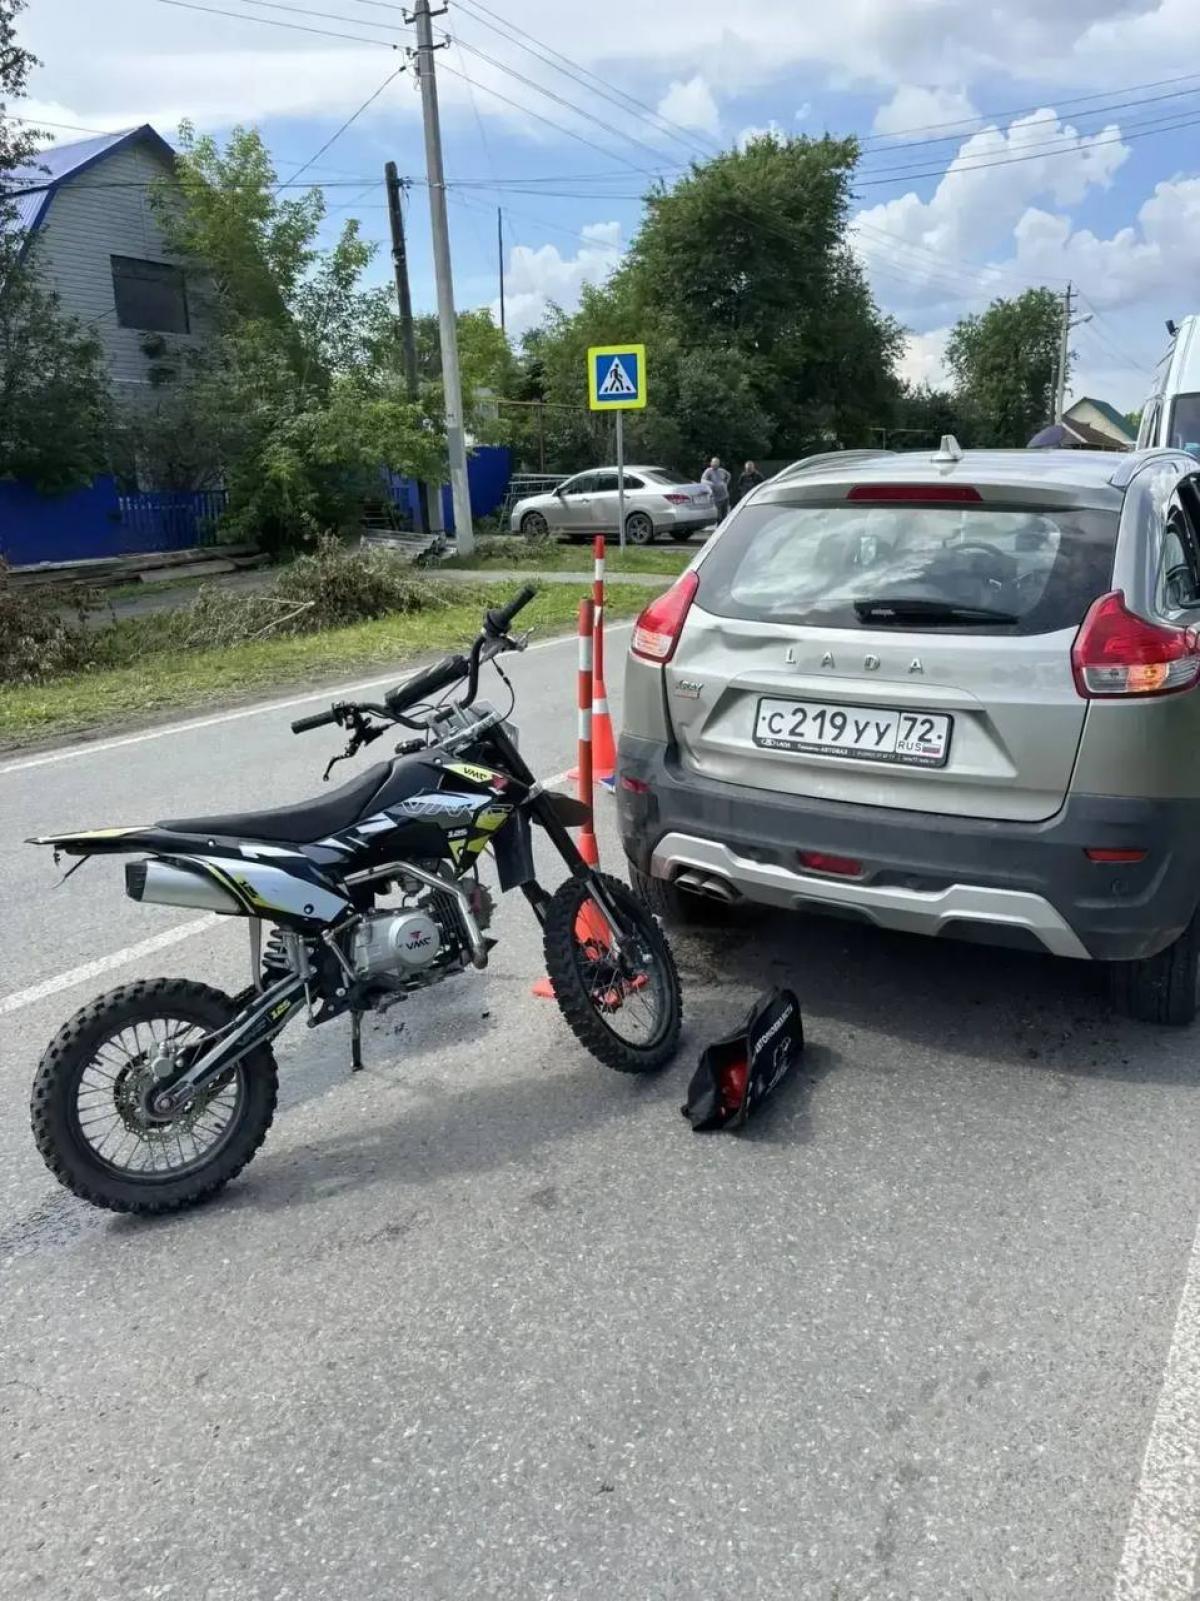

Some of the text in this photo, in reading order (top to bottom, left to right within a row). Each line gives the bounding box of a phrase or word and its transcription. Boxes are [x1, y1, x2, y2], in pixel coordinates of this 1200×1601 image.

[784, 648, 925, 675] LADA
[902, 716, 935, 743] 72
[898, 741, 922, 752] RUS
[405, 937, 432, 950] VMC
